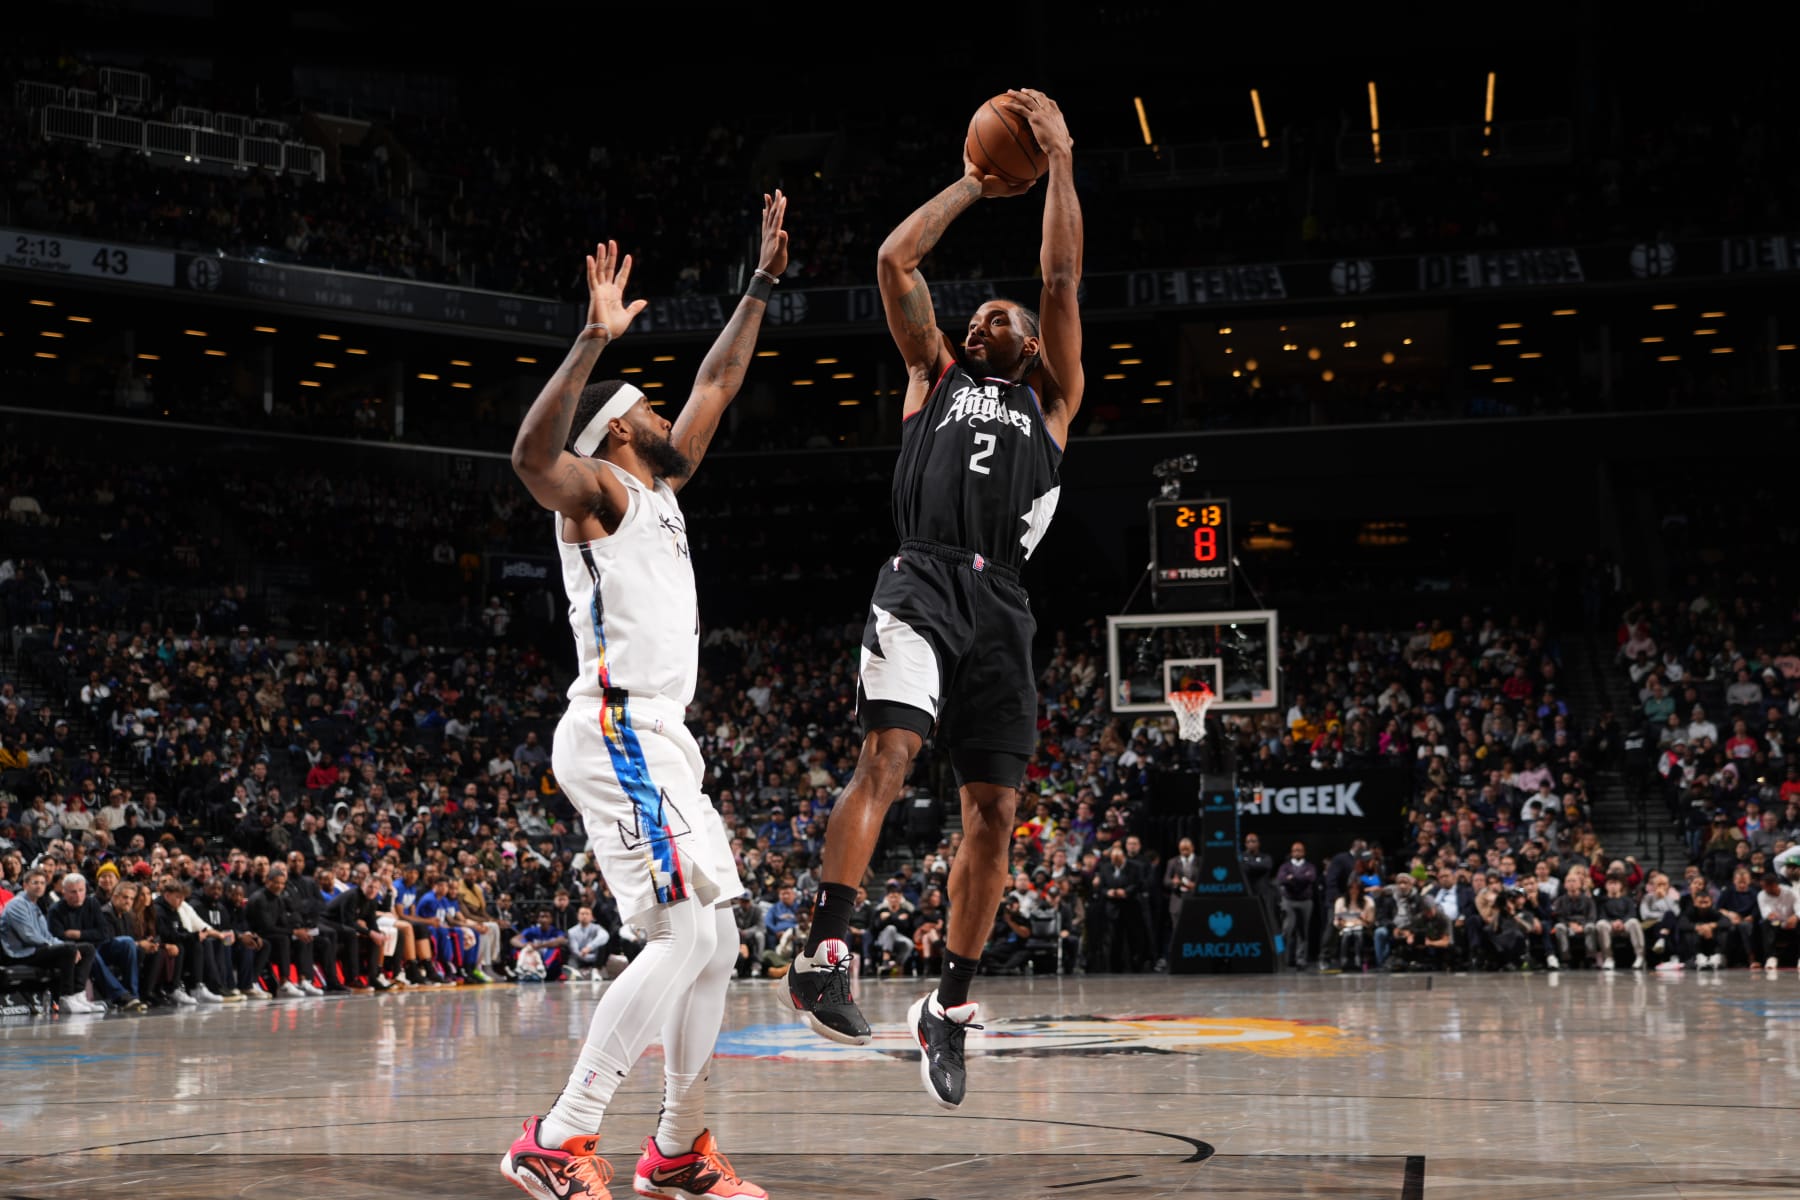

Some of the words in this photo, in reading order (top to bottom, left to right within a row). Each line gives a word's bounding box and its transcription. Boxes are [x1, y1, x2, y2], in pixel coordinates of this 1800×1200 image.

[15, 236, 61, 258] 2:13
[29, 257, 71, 271] Quarter
[92, 248, 129, 275] 43
[1419, 248, 1584, 290] DEFENSE
[1127, 264, 1288, 306] DEFENSE
[969, 432, 997, 475] 2
[1176, 506, 1221, 528] 2:13
[1194, 527, 1216, 561] 8
[501, 561, 547, 579] jetBlue
[1178, 567, 1227, 579] TISSOT
[1198, 883, 1243, 893] BARCLAYS
[1182, 942, 1263, 958] BARCLAYS
